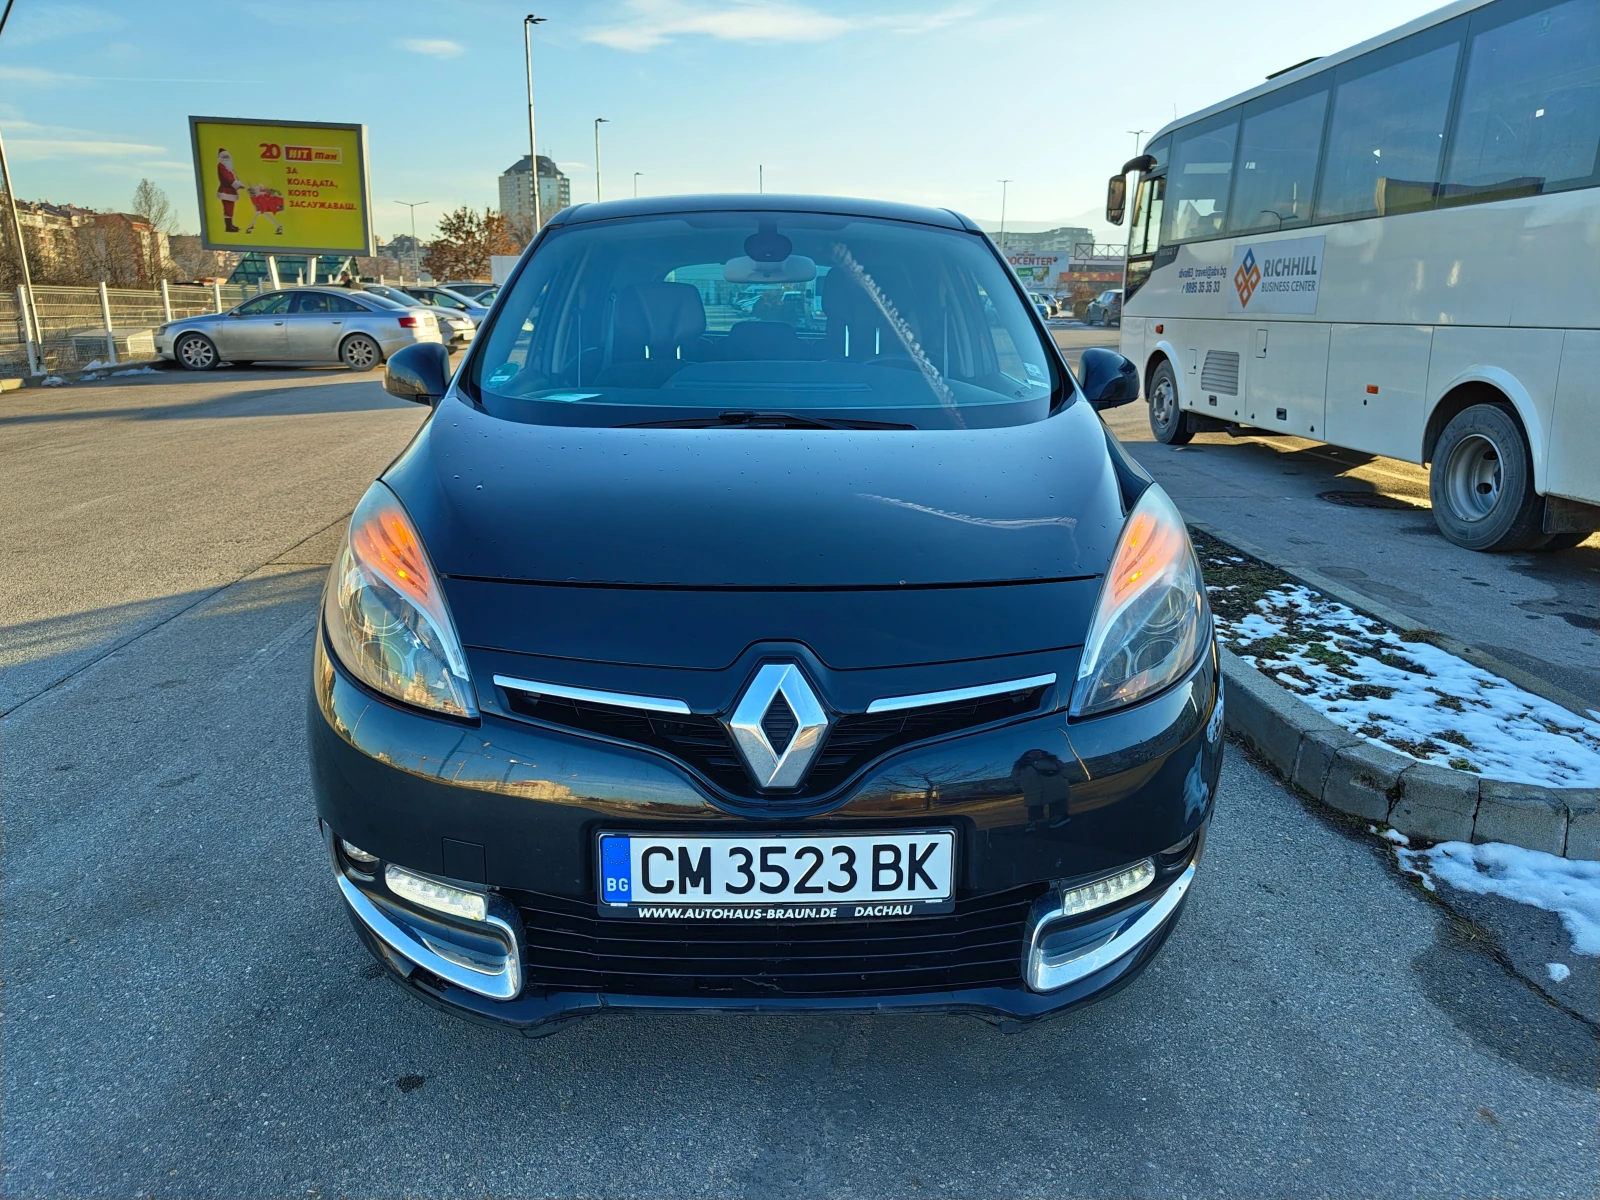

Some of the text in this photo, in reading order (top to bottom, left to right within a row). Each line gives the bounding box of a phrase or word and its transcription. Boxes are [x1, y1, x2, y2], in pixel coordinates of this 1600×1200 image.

[259, 143, 281, 159] 20
[288, 149, 310, 159] HIT
[287, 178, 338, 188] КОЛЕДАТА,
[288, 190, 319, 198] КОЯТО
[289, 200, 357, 210] ЗАСЛУЖАВАШ.
[1263, 256, 1317, 277] RICHHILL
[1261, 281, 1316, 292] BUSINESS CENTER
[641, 843, 939, 895] CM 3523 BK
[607, 878, 629, 892] BG
[638, 905, 913, 919] WWW.AUTOHAUS-BRAUN.DE DACHAU
